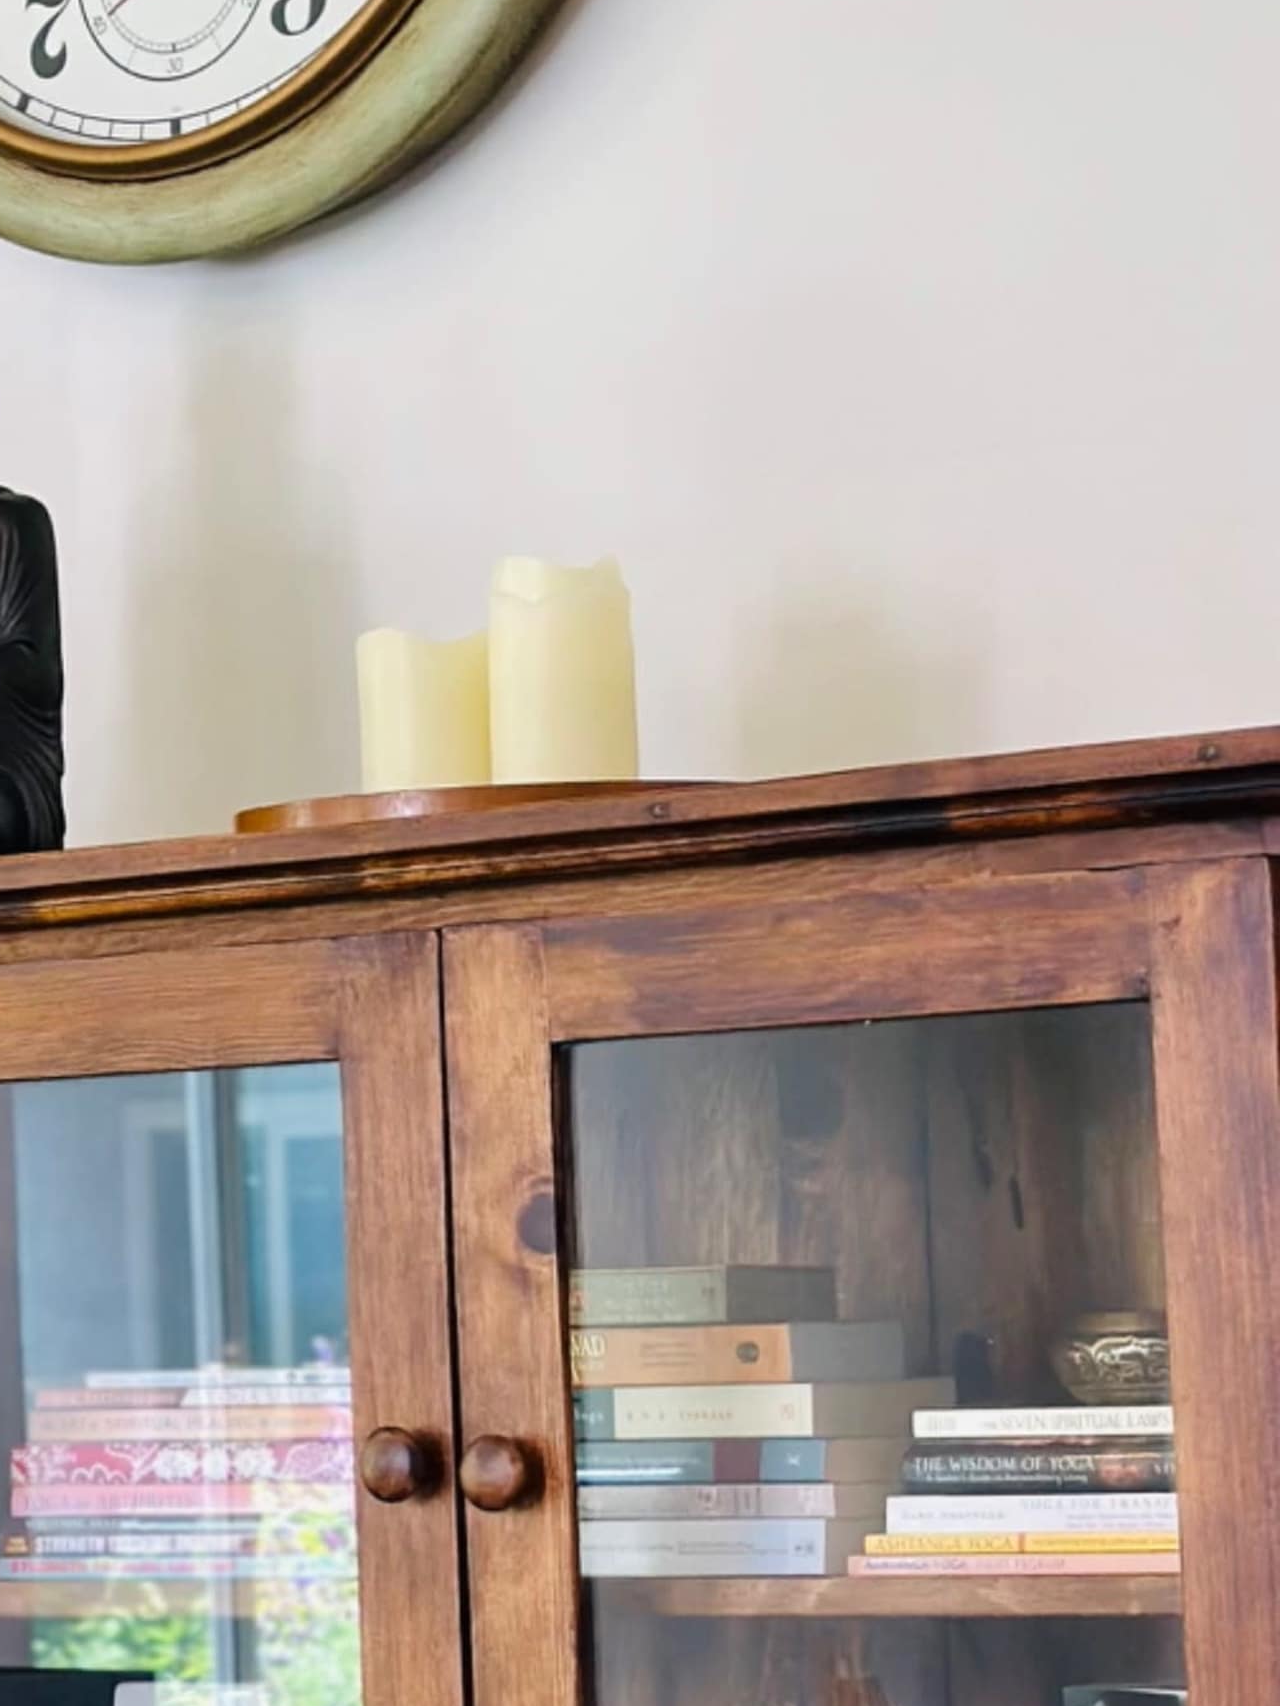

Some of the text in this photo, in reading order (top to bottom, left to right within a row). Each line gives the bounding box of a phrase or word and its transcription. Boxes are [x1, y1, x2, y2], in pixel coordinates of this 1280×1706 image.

[999, 1413, 1047, 1431] SEVEN
[1051, 1412, 1121, 1430] SPIRITUAL
[913, 1456, 944, 1472] THE
[948, 1456, 1016, 1472] WISDOM
[1020, 1455, 1042, 1471] OF
[1048, 1455, 1096, 1471] YOGA
